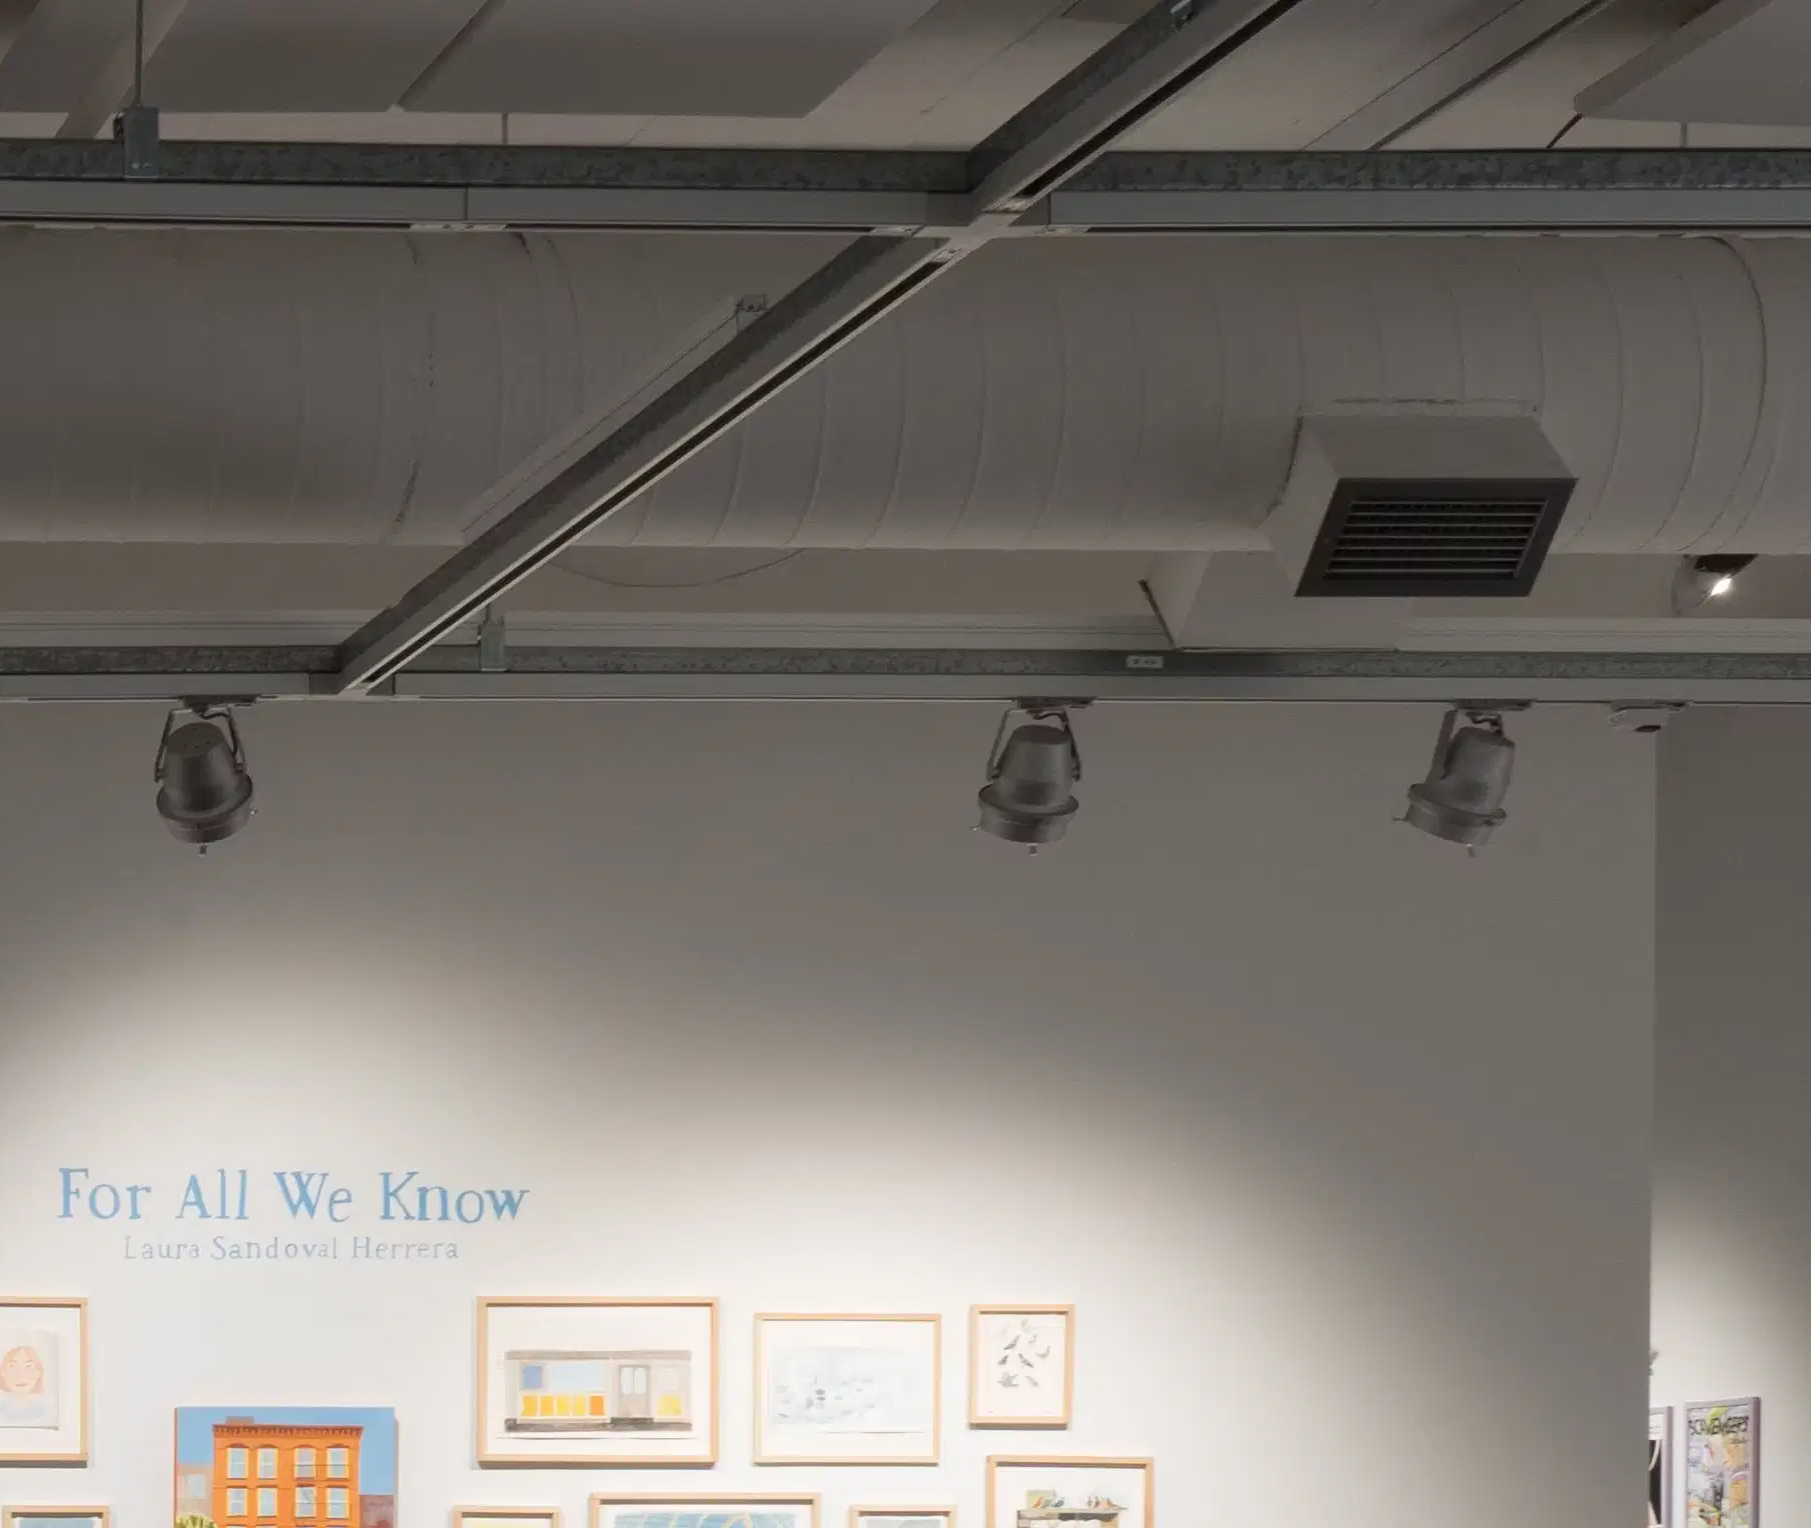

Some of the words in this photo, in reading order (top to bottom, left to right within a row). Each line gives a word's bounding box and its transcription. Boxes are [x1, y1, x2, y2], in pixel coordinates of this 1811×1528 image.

[56, 1167, 153, 1221] For
[174, 1167, 250, 1221] All
[272, 1170, 354, 1224] We
[378, 1170, 531, 1225] Know
[124, 1235, 201, 1261] Laura
[210, 1235, 338, 1261] Sandoval
[351, 1235, 460, 1261] Herrera
